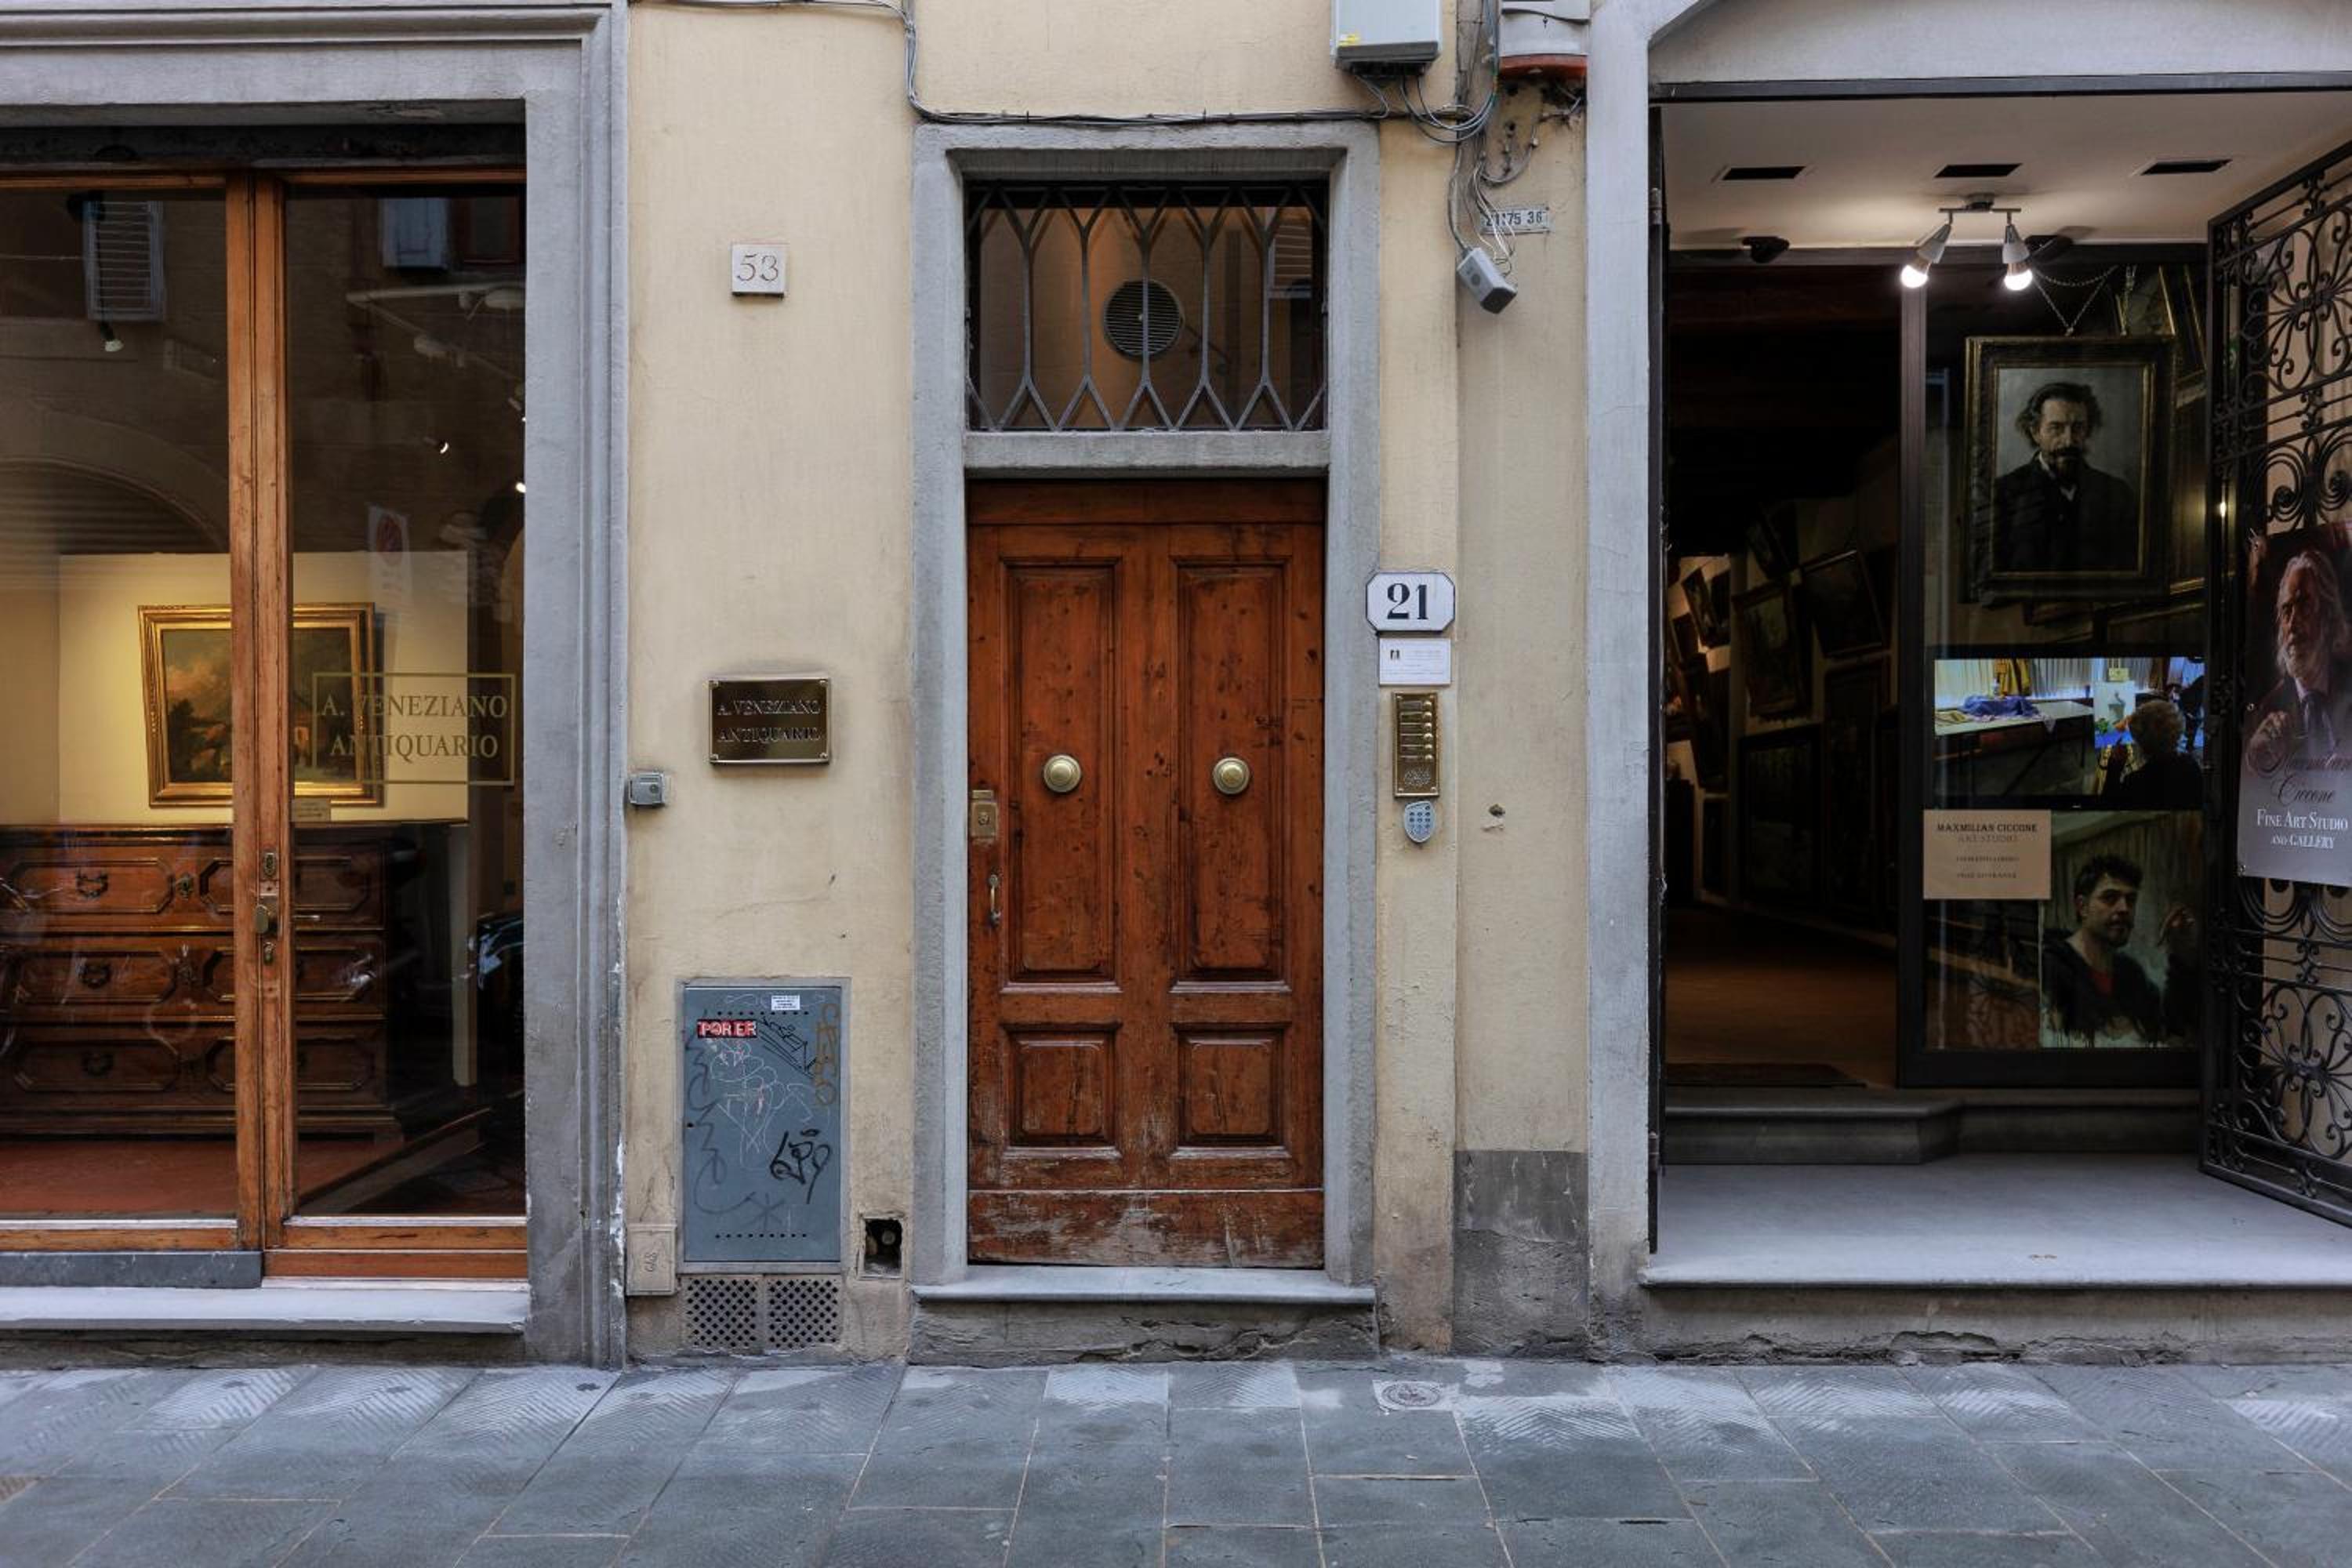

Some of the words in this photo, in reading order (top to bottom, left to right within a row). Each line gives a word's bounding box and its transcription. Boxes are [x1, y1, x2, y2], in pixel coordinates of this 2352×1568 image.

[737, 252, 779, 281] 53
[1386, 583, 1428, 620] 21
[360, 695, 508, 718] VENEZIANO
[733, 699, 821, 715] VENEZIANO
[329, 734, 499, 764] ANTIQUARIO
